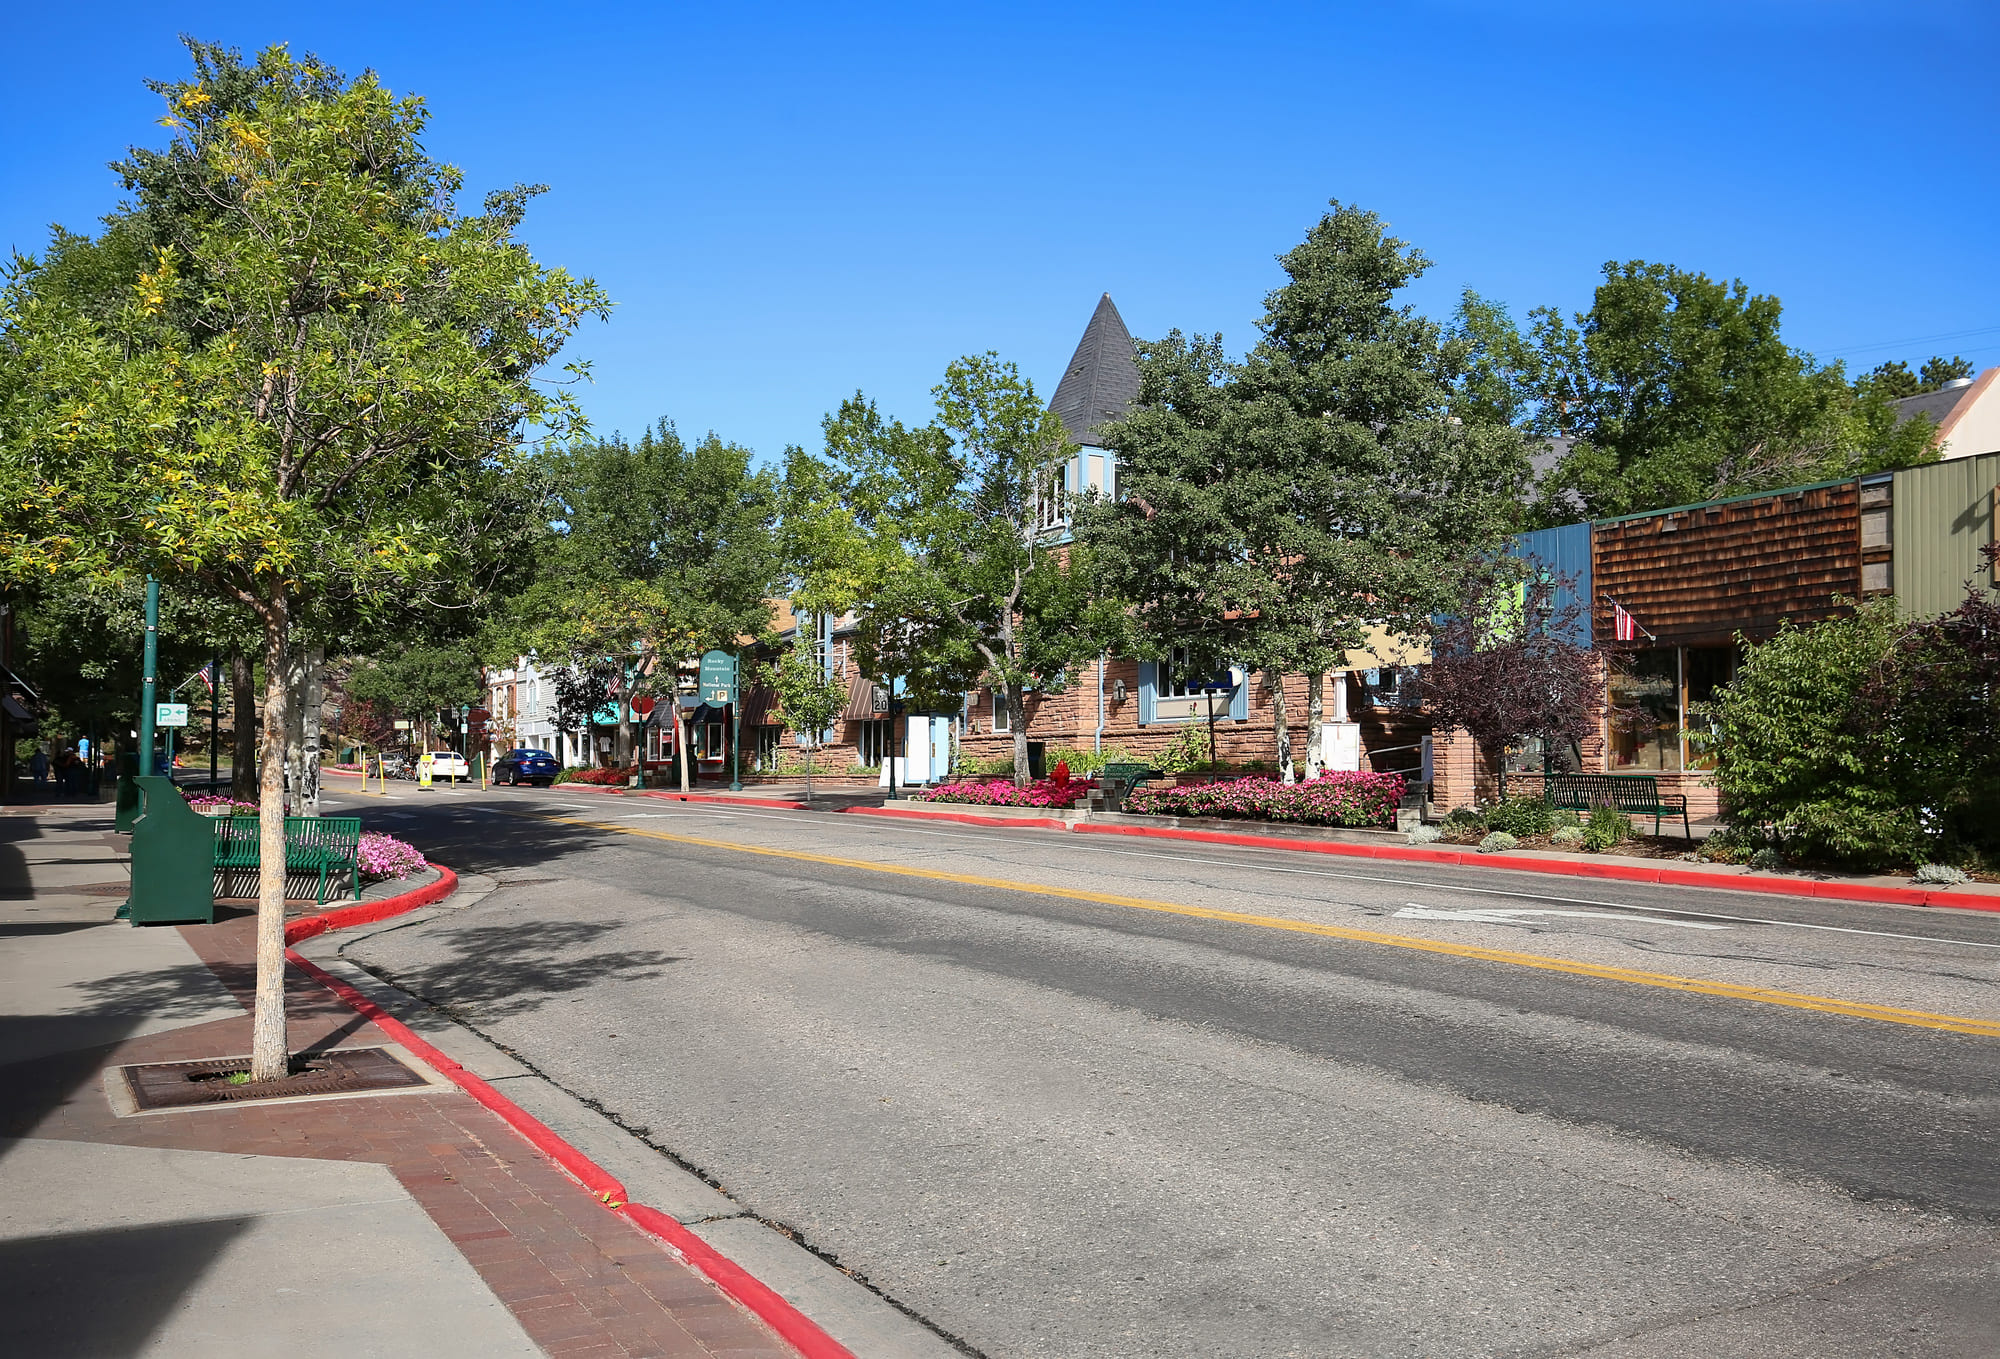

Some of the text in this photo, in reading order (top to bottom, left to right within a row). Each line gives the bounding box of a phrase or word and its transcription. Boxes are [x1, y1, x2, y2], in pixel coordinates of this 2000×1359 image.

[719, 691, 726, 699] P
[874, 700, 887, 710] 20
[159, 707, 172, 721] P
